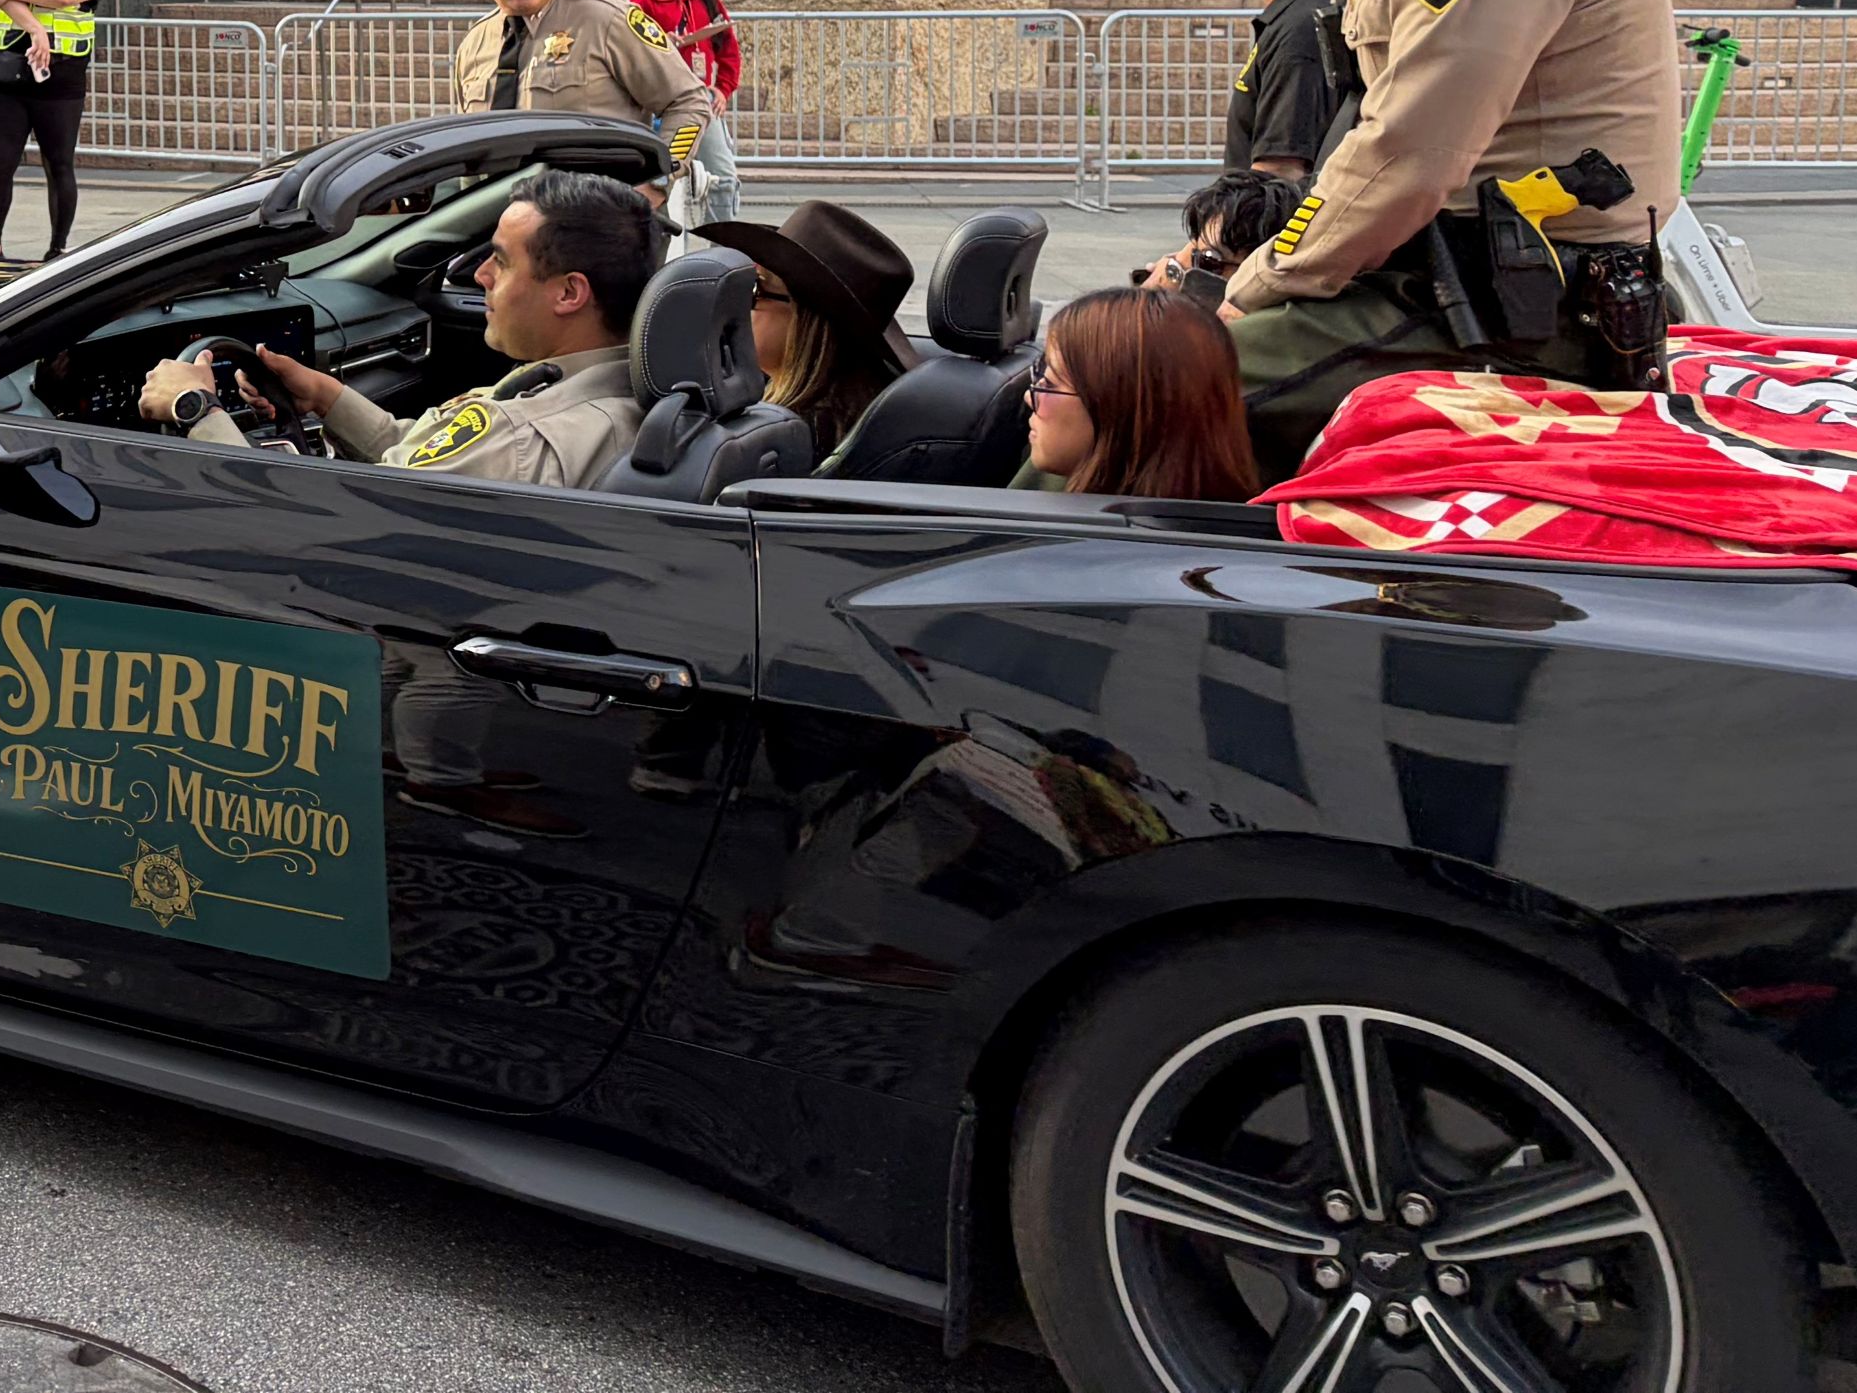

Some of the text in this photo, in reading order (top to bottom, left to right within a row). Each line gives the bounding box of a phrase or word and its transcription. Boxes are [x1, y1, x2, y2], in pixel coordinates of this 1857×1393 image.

[1690, 244, 1701, 260] On
[1698, 259, 1714, 282] Lime
[1715, 289, 1732, 311] Uber
[1, 743, 349, 858] PAUL MIYAMOTO
